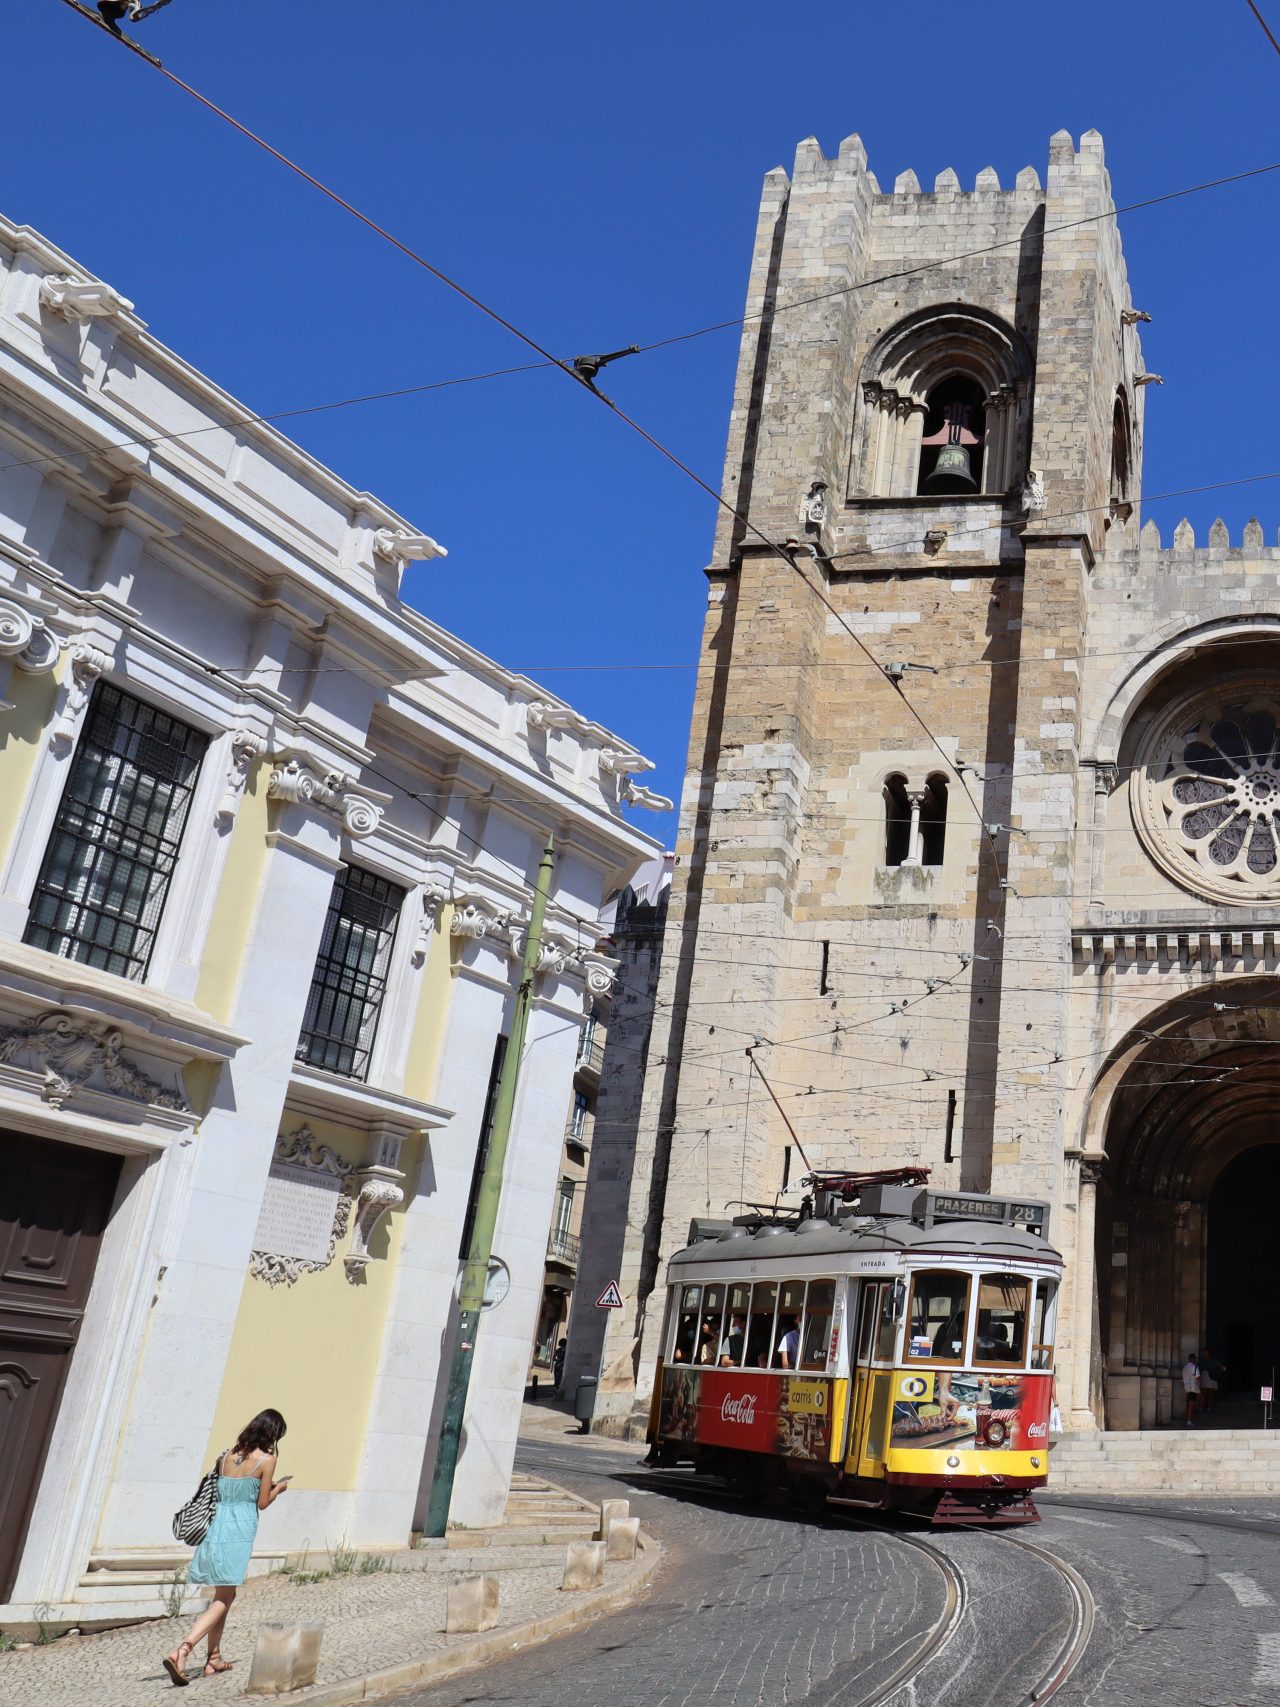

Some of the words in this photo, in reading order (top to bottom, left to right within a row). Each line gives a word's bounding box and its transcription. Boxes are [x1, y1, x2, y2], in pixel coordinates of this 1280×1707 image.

[936, 1199, 999, 1213] PRAZERES
[1014, 1206, 1034, 1220] 28
[791, 1389, 811, 1405] carris
